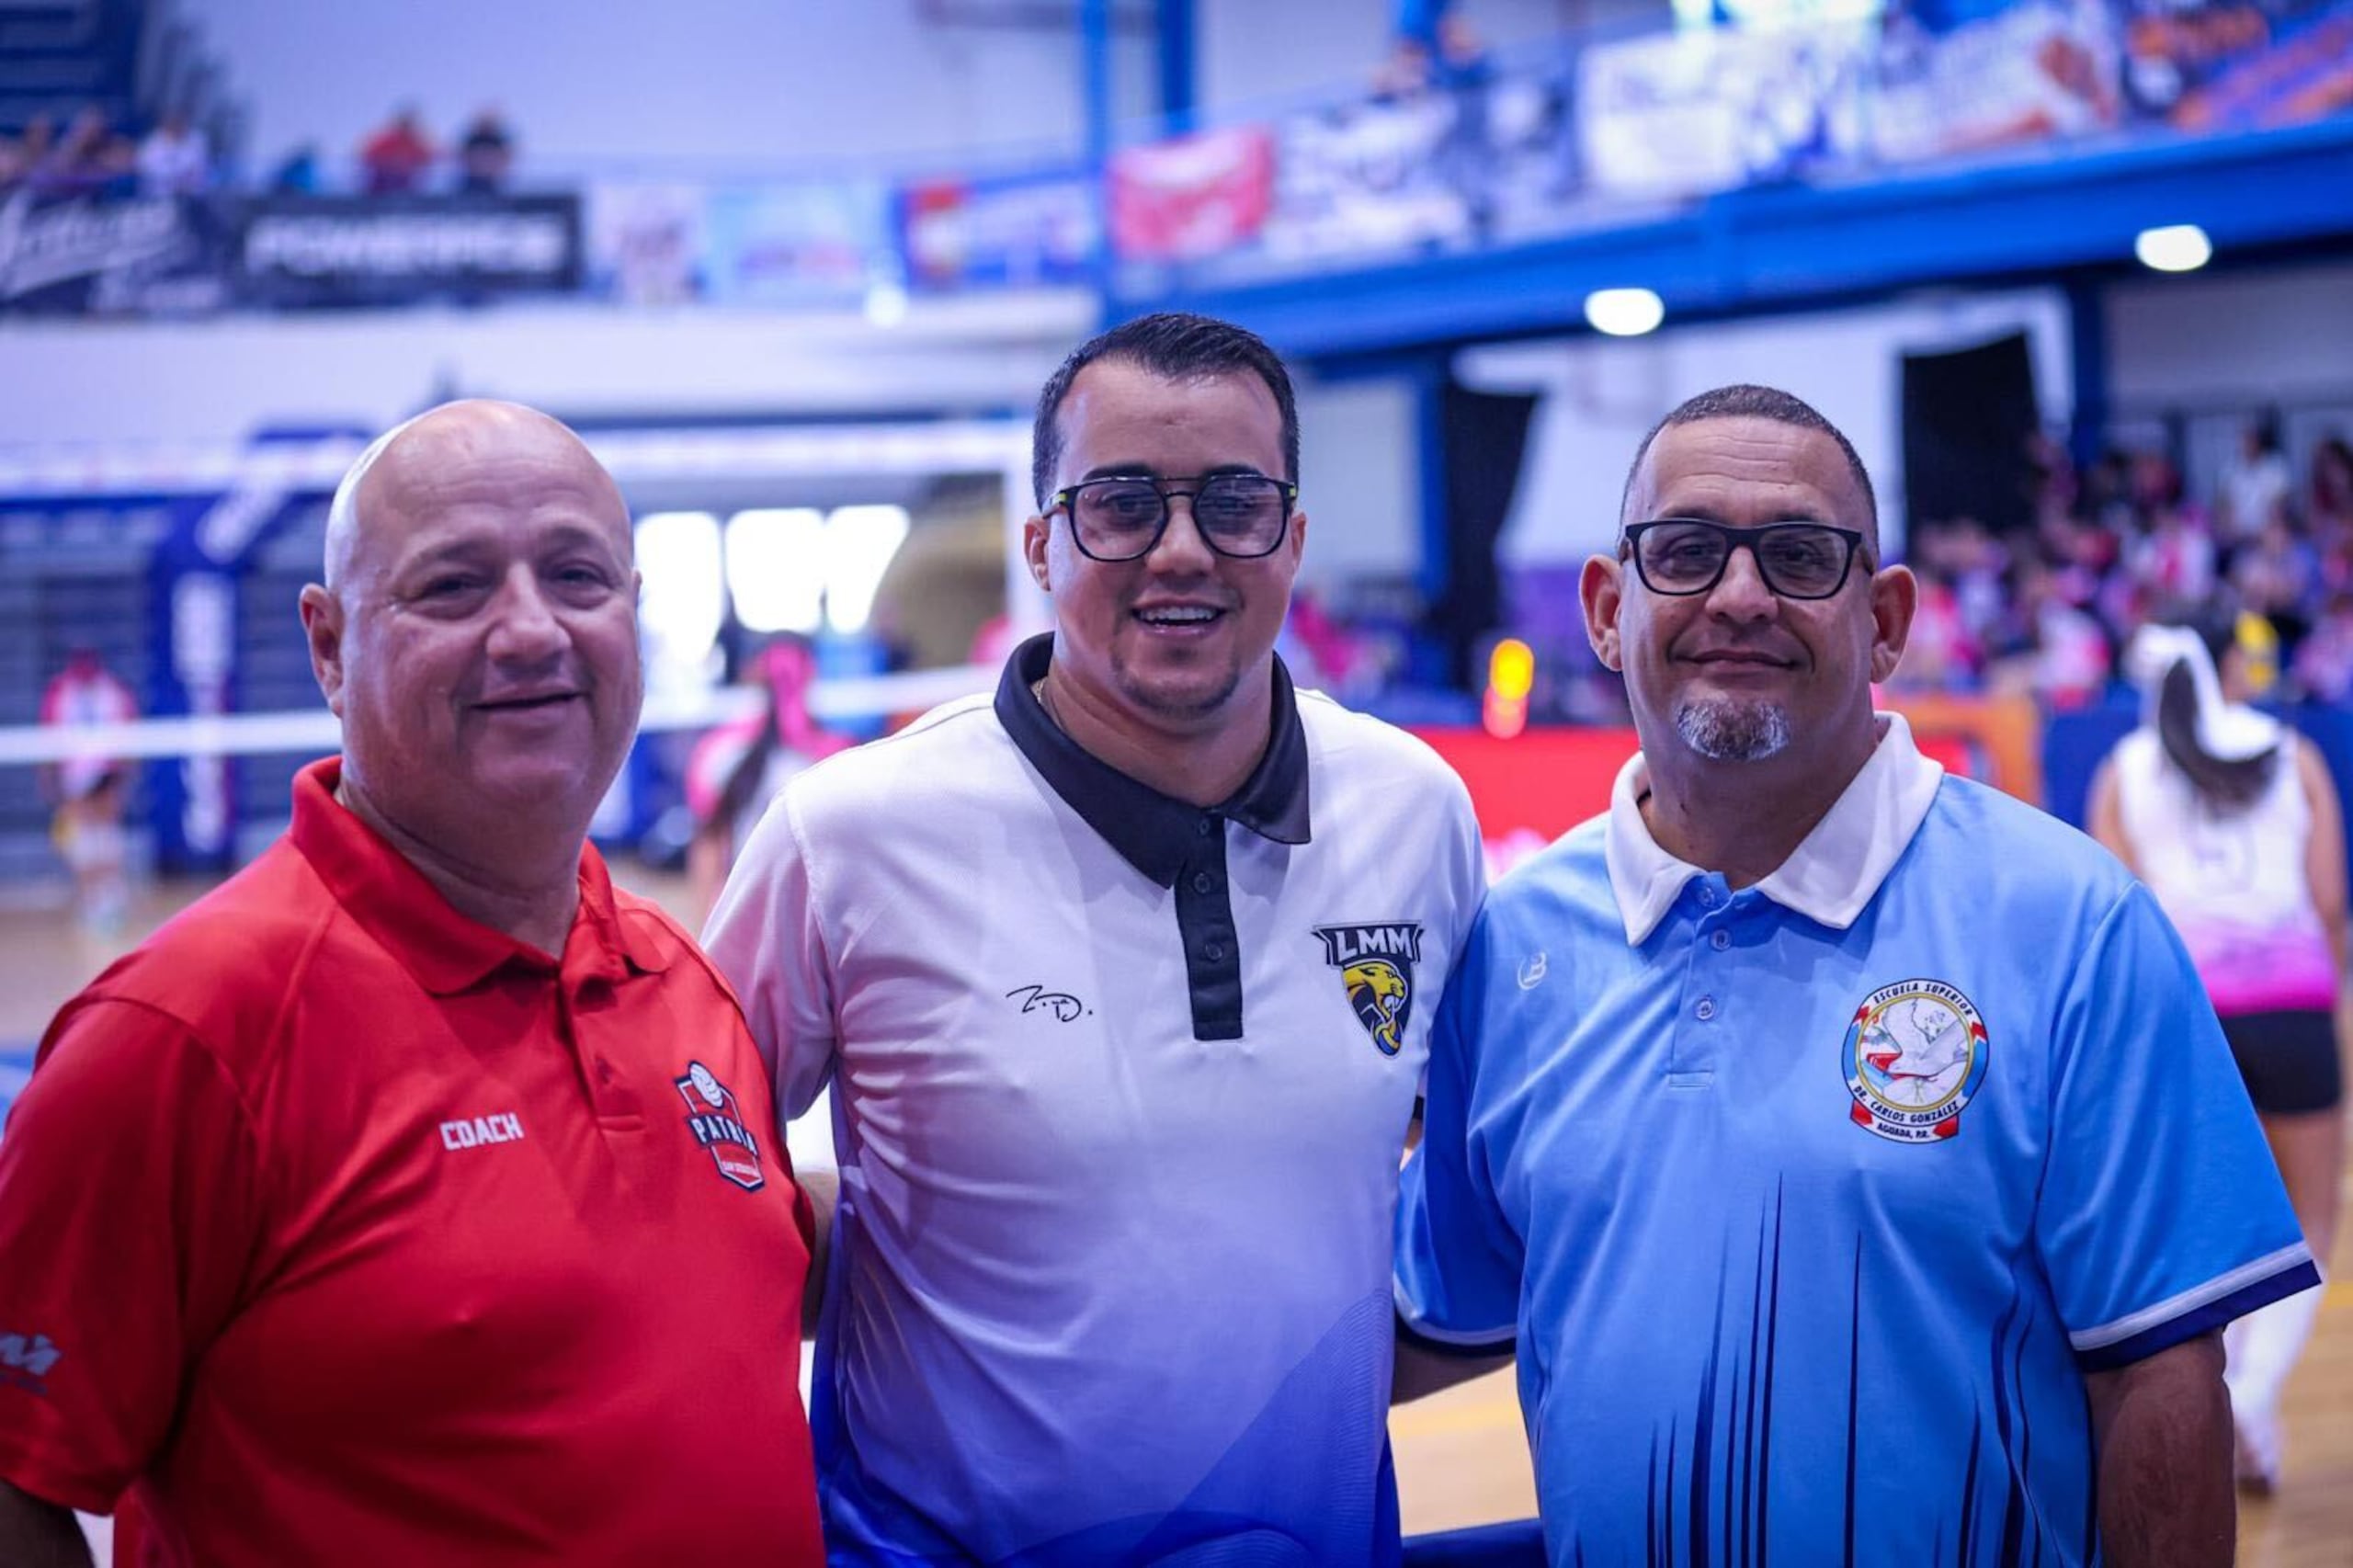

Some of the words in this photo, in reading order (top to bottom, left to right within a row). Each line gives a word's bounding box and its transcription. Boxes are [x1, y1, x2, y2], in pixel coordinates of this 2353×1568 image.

[1336, 926, 1414, 962] LMM
[1873, 983, 1919, 1004] ESCUELA
[1925, 983, 1972, 1016] SUPERIOR
[1853, 1085, 1869, 1101] DR.
[1870, 1101, 1905, 1121] CARLOS
[439, 1112, 524, 1151] COACH
